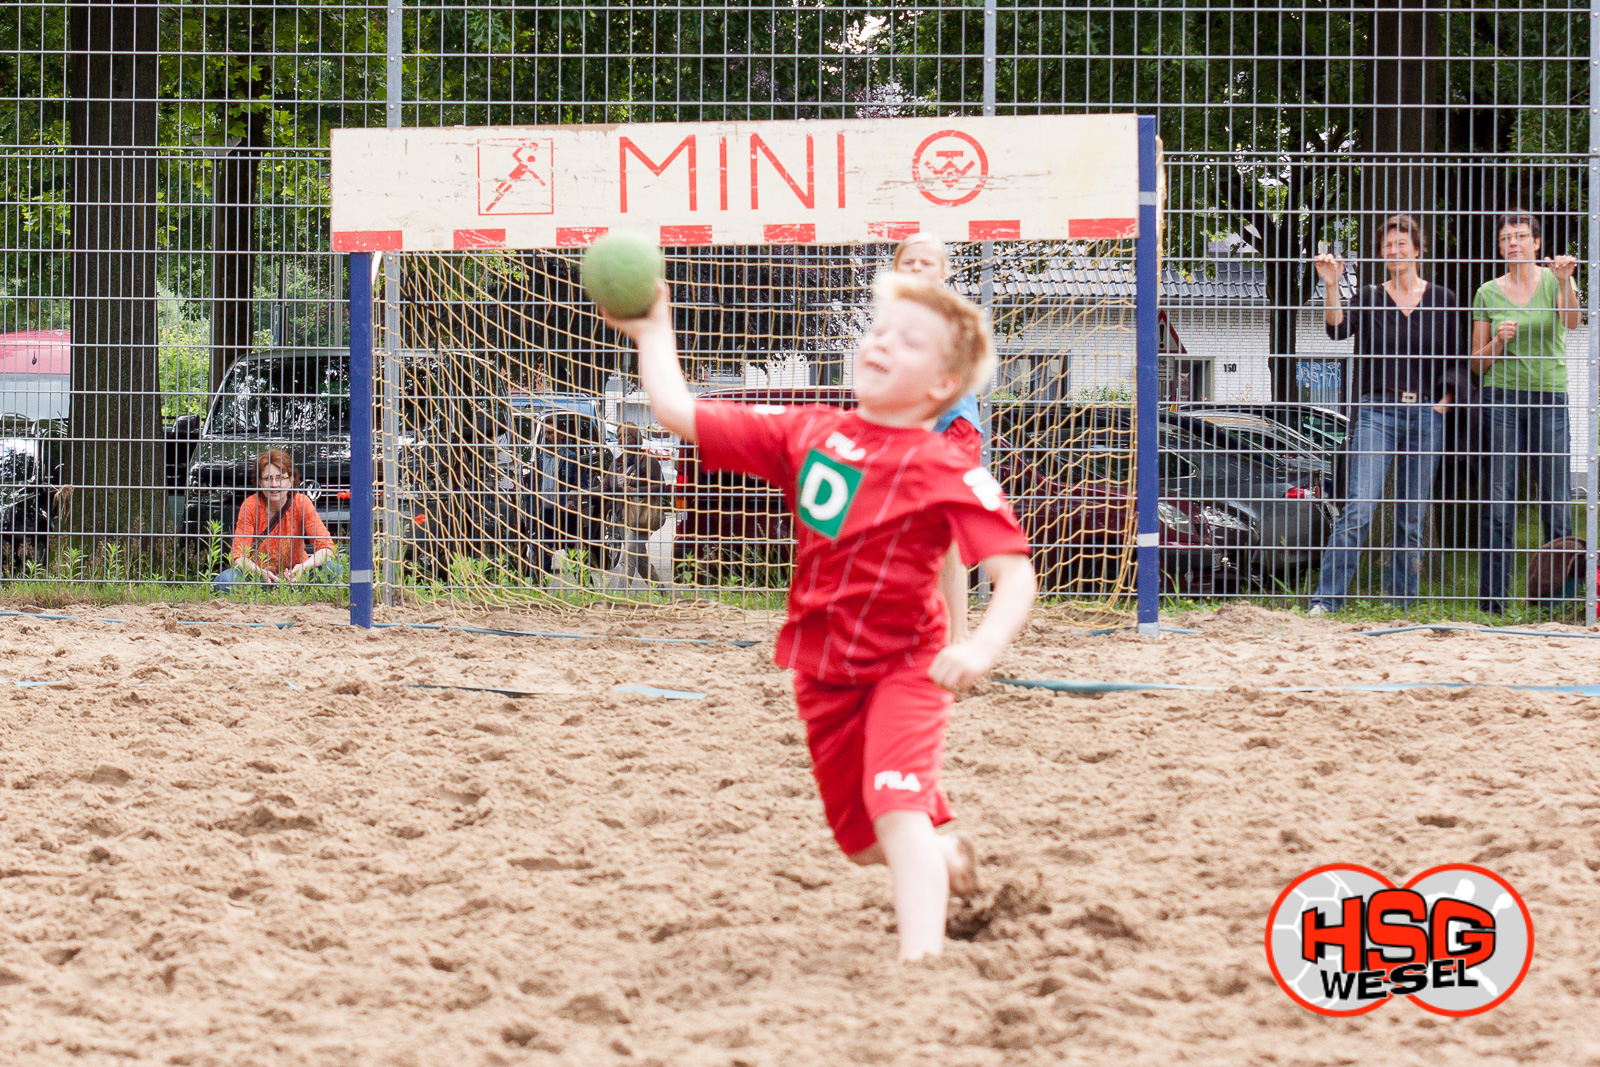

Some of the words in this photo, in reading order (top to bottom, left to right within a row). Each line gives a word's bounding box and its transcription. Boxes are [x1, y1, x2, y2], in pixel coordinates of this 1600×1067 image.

[619, 133, 845, 213] MINI
[1223, 363, 1237, 373] 150
[801, 461, 849, 521] D
[874, 770, 921, 792] FILA
